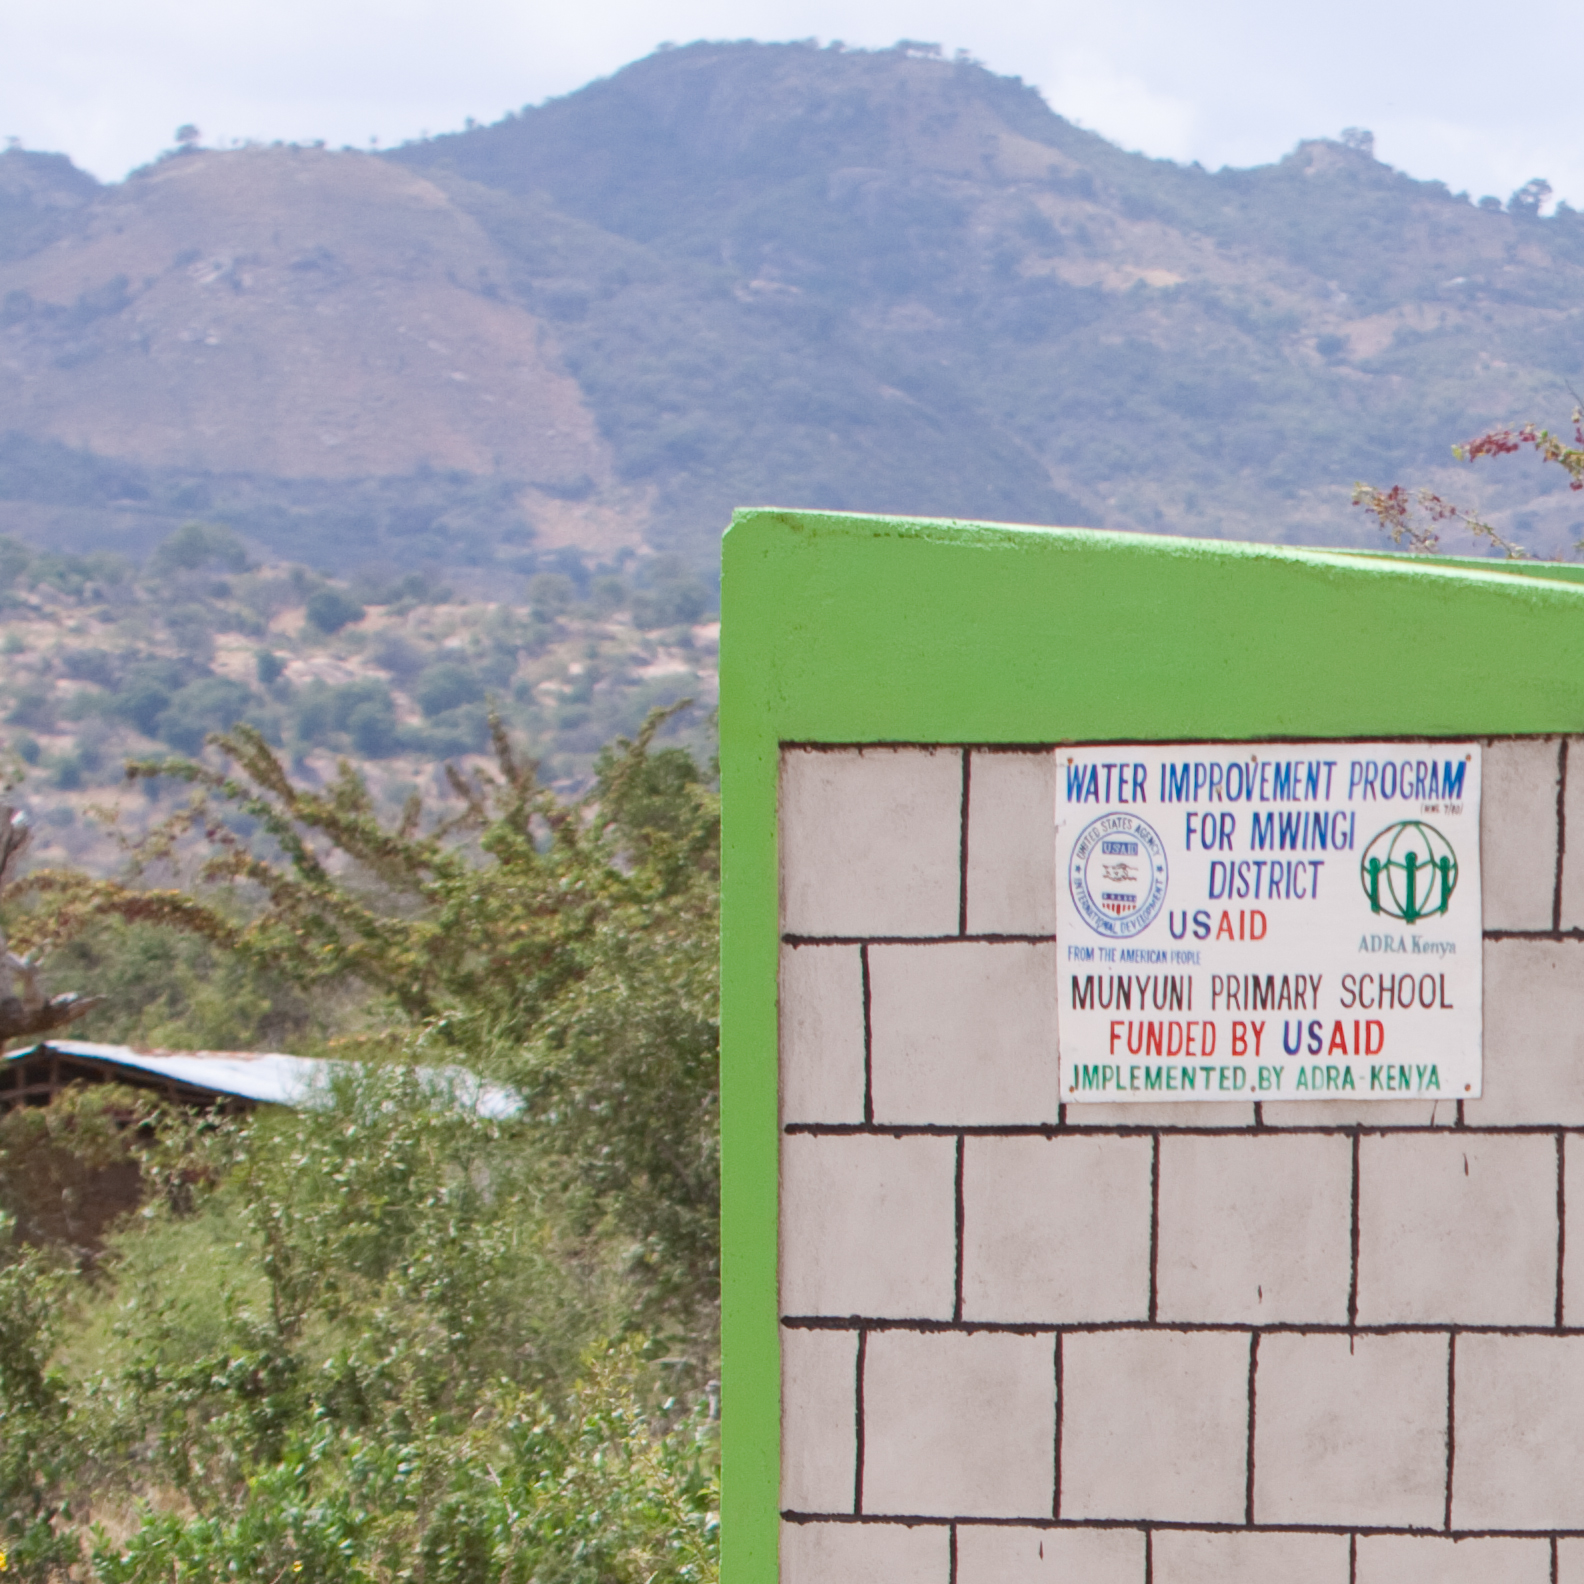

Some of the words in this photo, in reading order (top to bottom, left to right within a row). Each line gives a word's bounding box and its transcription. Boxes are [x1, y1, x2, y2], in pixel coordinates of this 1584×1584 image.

[1066, 762, 1147, 802] WATER
[1160, 761, 1336, 802] IMPROVEMENT
[1348, 760, 1466, 800] PROGRAM
[1101, 818, 1132, 832] STATES
[1135, 825, 1161, 856] AGENCY
[1186, 812, 1235, 850] FOR
[1250, 811, 1354, 850] MWINGI
[1104, 843, 1137, 855] USAID
[1209, 861, 1324, 899] DISTRICT
[1169, 910, 1267, 940] USAID
[1068, 946, 1094, 962] FROM
[1099, 947, 1116, 963] THE
[1120, 948, 1167, 964] AMERICAN
[1171, 950, 1201, 965] PEOPLE
[1359, 935, 1407, 953] ADRA
[1412, 935, 1456, 959] Kenya
[1072, 975, 1192, 1010] MUNYUNI
[1212, 974, 1322, 1010] PRIMARY
[1340, 974, 1453, 1009] SCHOOL
[1110, 1021, 1216, 1056] FUNDED
[1232, 1021, 1265, 1056] BY
[1283, 1021, 1384, 1055] USAID
[1073, 1065, 1246, 1091] IMPLEMENTED
[1258, 1066, 1284, 1090] BY
